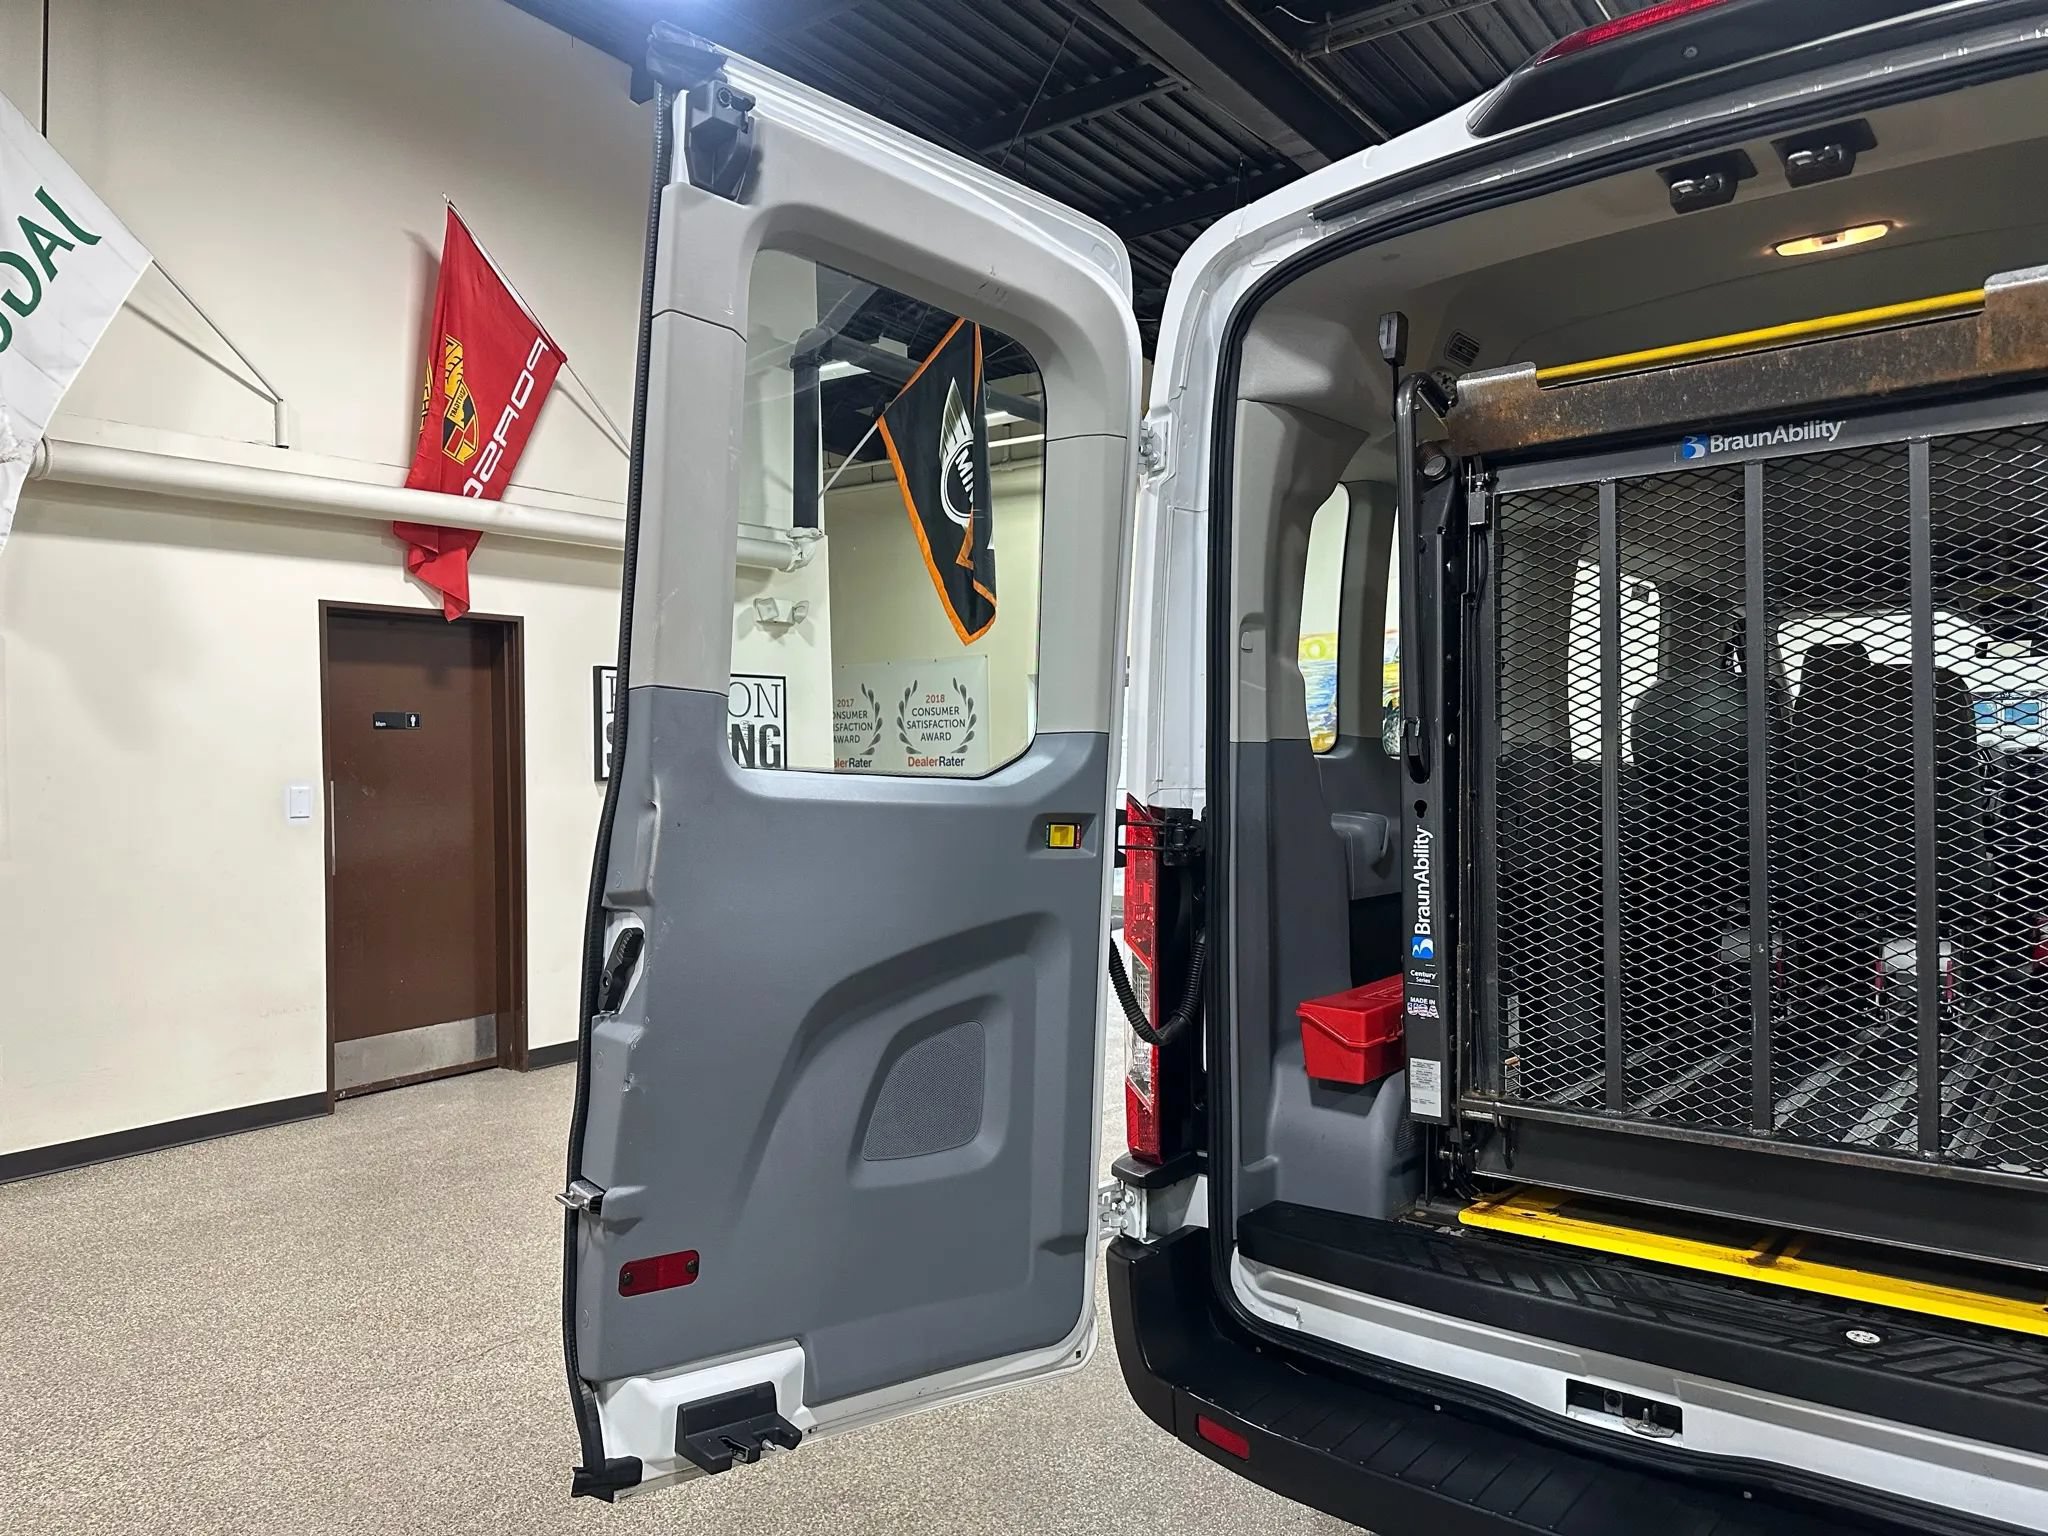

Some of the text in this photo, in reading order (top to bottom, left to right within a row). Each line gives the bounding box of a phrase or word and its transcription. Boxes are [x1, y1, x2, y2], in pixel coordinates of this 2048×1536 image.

[1710, 419, 1843, 453] BraunAbility
[836, 698, 855, 708] 2017
[925, 694, 945, 704] 2018
[911, 706, 960, 717] CONSUMER
[906, 718, 966, 730] SATISFACTION
[920, 732, 952, 742] AWARD
[907, 755, 965, 768] DealerRater
[1412, 826, 1434, 935] BraunAbility
[1409, 970, 1437, 980] Century
[1407, 1002, 1440, 1019] USA
